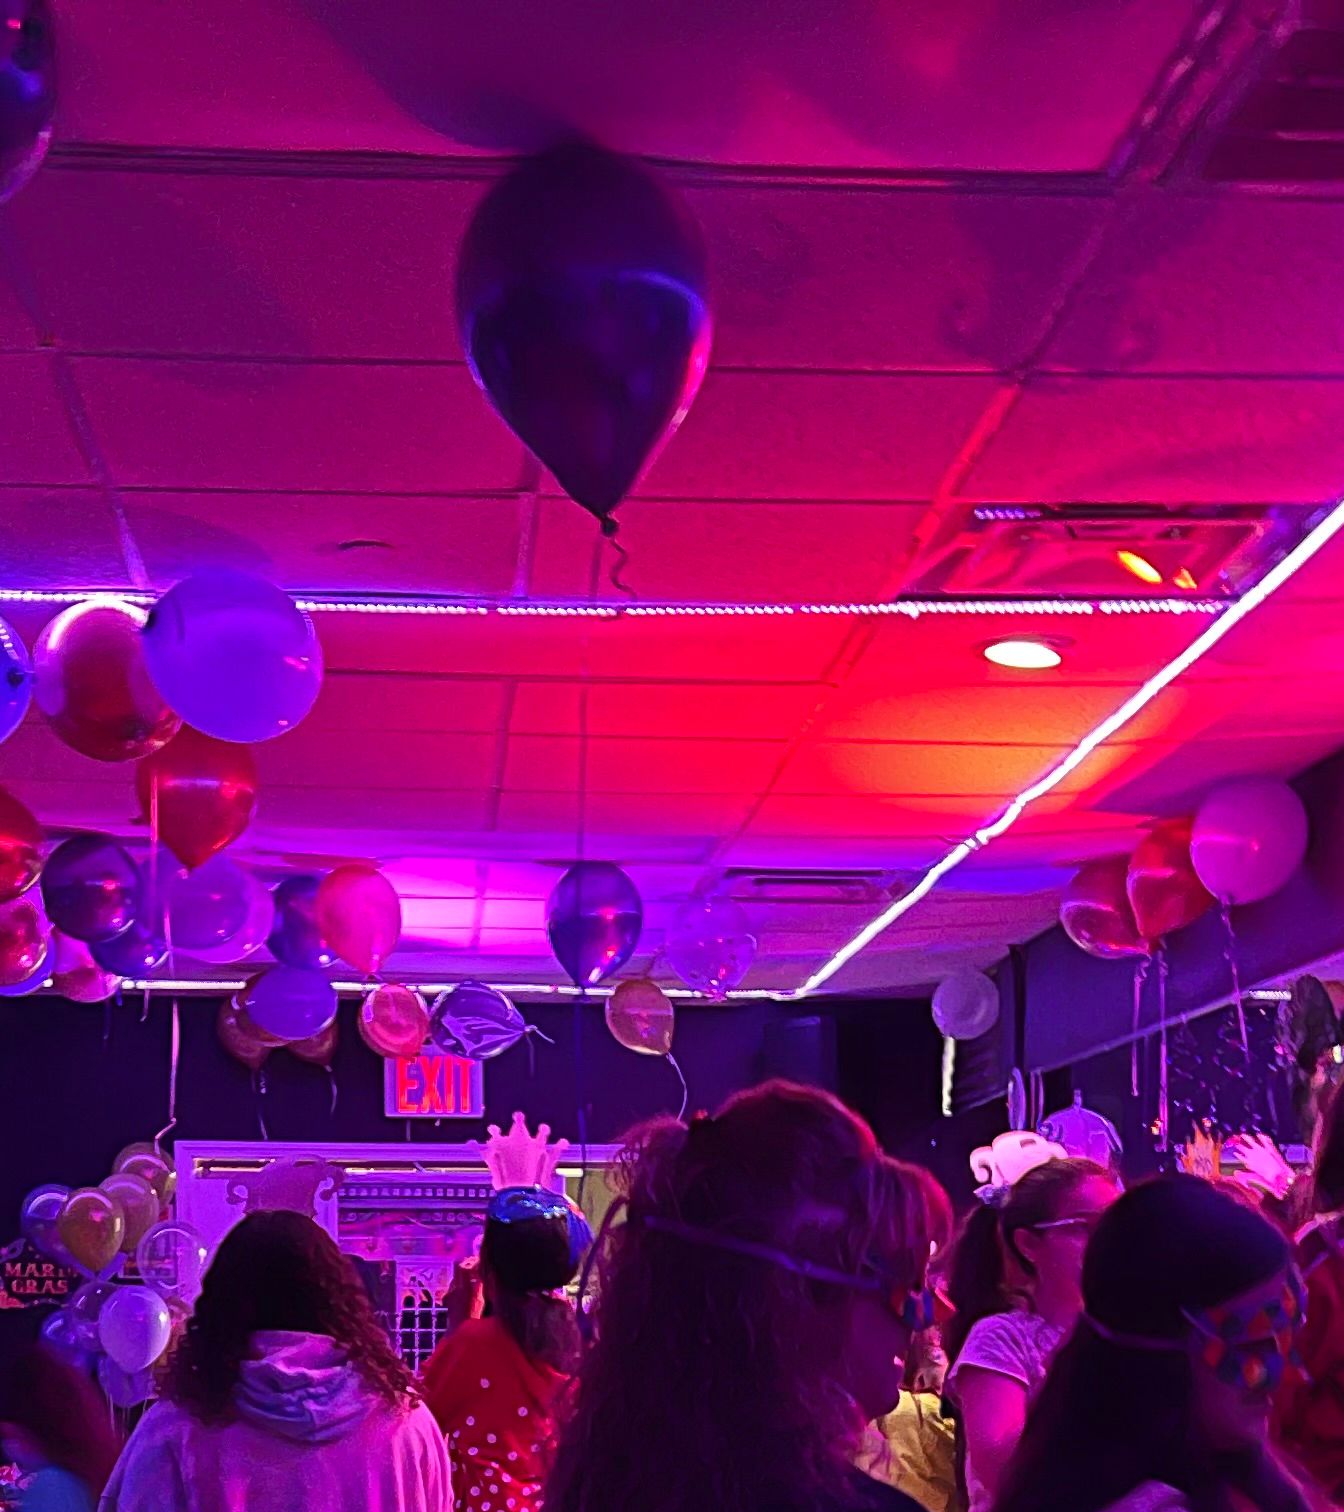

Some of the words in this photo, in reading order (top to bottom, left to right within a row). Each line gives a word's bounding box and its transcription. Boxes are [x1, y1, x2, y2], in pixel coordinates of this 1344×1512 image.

[396, 1055, 476, 1114] EXIT
[4, 1262, 80, 1278] MAR
[11, 1279, 69, 1294] GRAS
